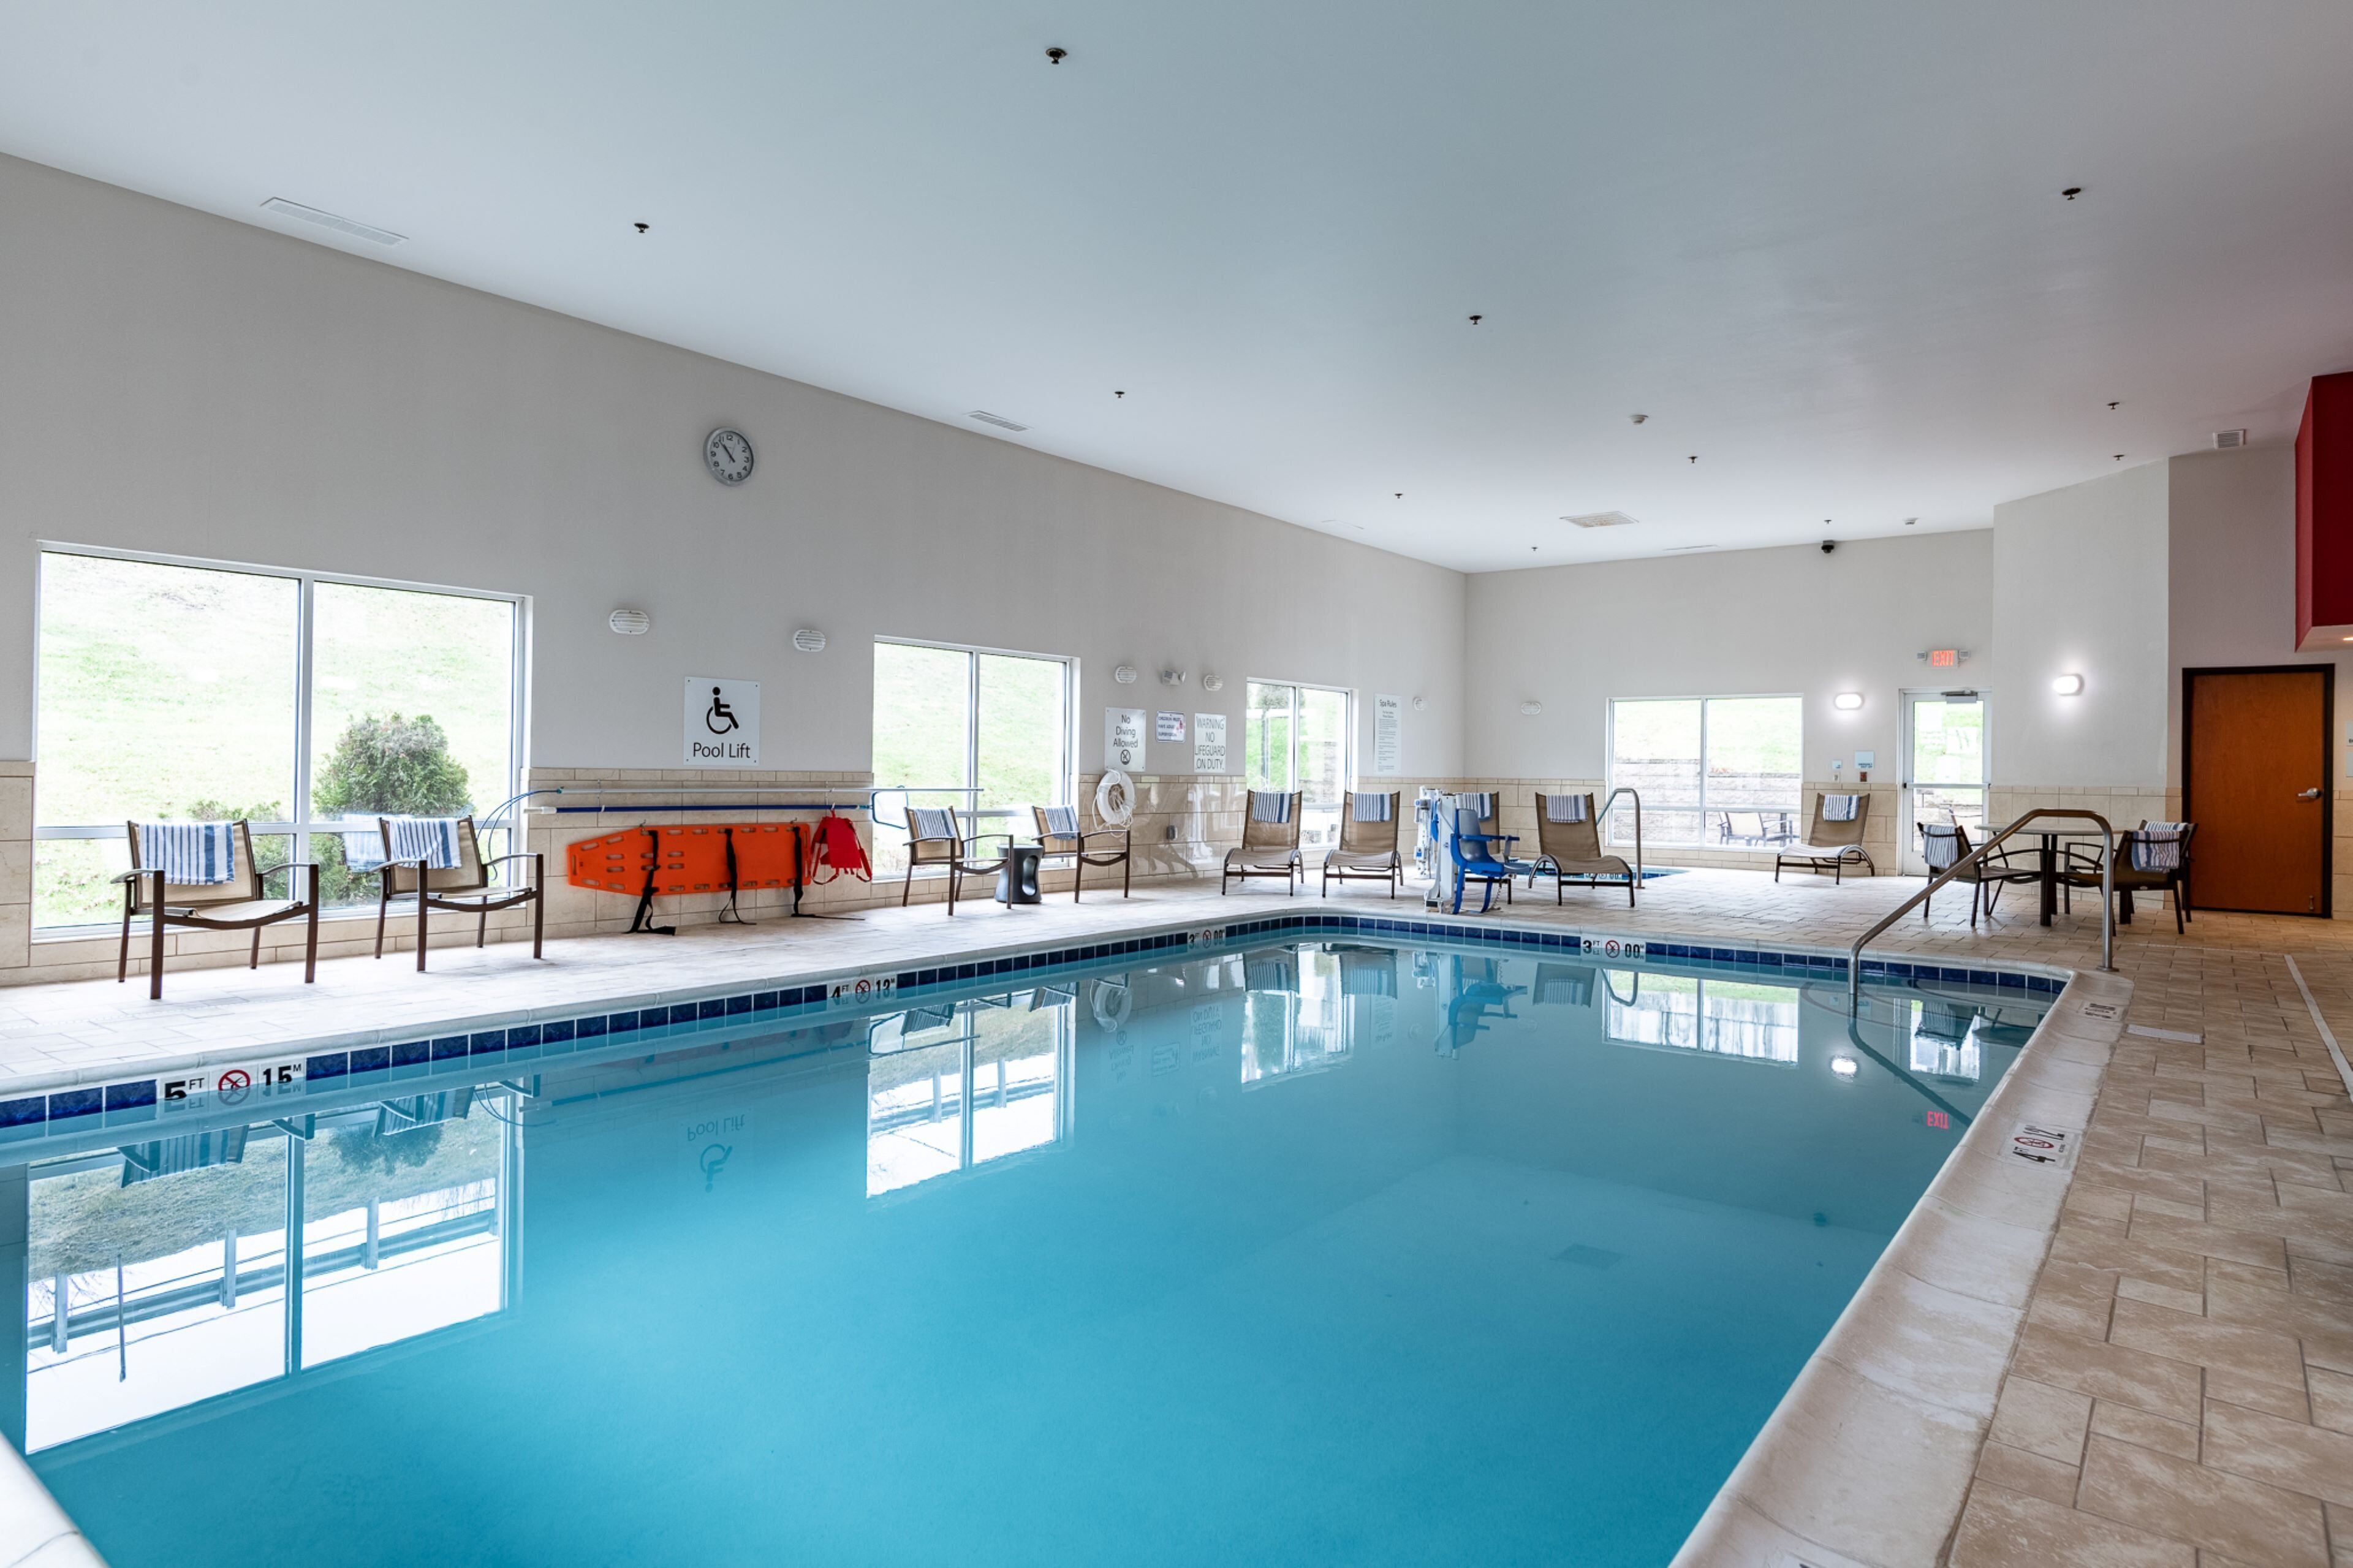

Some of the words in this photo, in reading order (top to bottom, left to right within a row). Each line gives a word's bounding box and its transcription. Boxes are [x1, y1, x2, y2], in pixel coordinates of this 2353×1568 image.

[1932, 650, 1954, 667] EXIT
[1121, 714, 1131, 724] No
[1197, 718, 1224, 730] WARNING
[1116, 725, 1136, 738] Diving
[1205, 732, 1215, 742] NO
[1113, 738, 1139, 748] Allowed
[693, 741, 724, 758] Pool
[729, 743, 751, 759] Lift
[1195, 745, 1225, 756] LIFEGUARD
[1197, 758, 1206, 770] ON
[1207, 759, 1223, 770] DUTY
